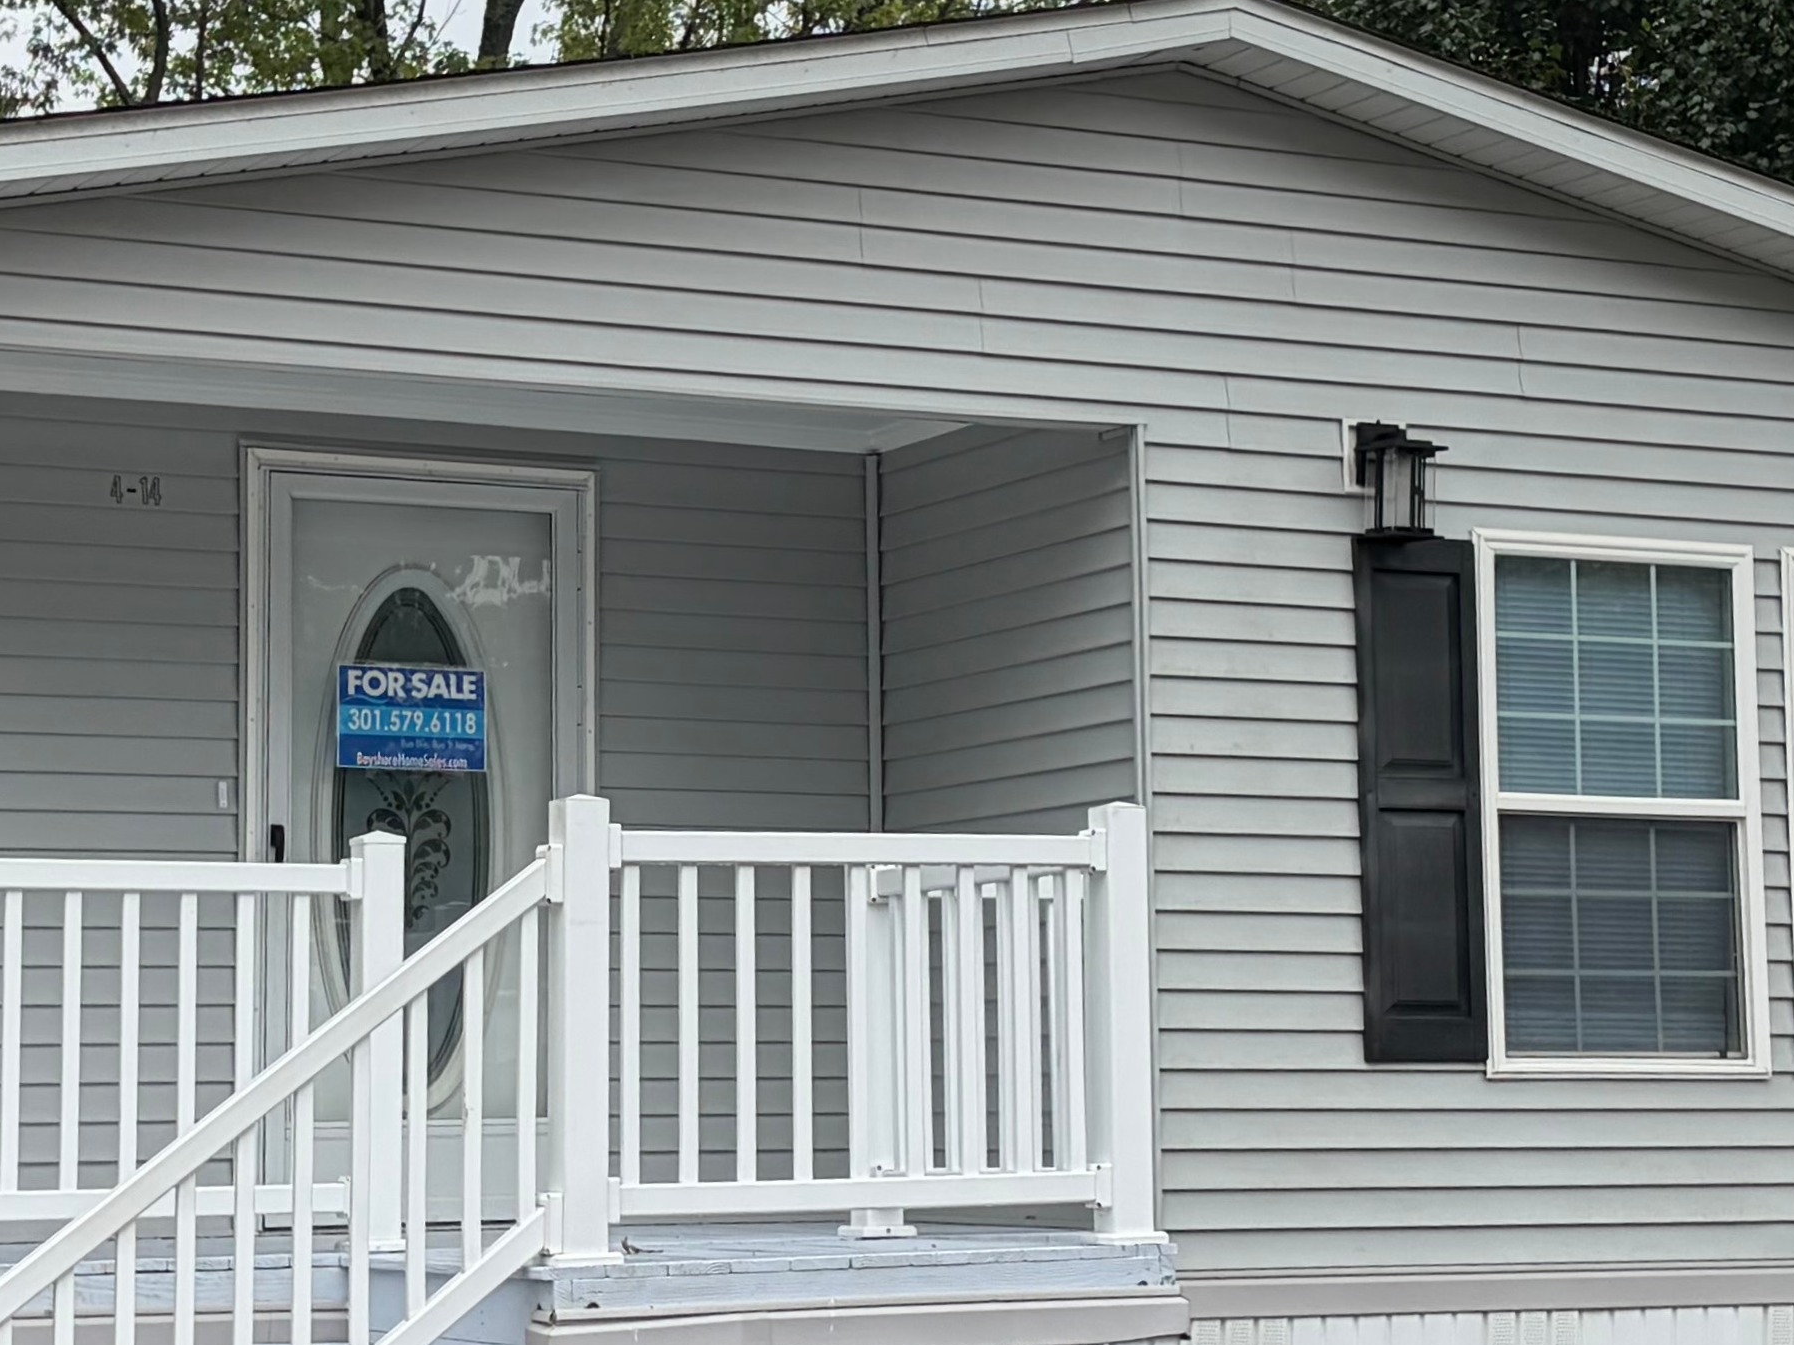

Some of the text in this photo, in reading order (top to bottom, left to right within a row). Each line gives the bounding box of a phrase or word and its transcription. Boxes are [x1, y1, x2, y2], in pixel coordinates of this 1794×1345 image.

[110, 474, 162, 506] 4-14
[347, 669, 477, 700] FOR SALE
[348, 708, 477, 735] 301.579.6118
